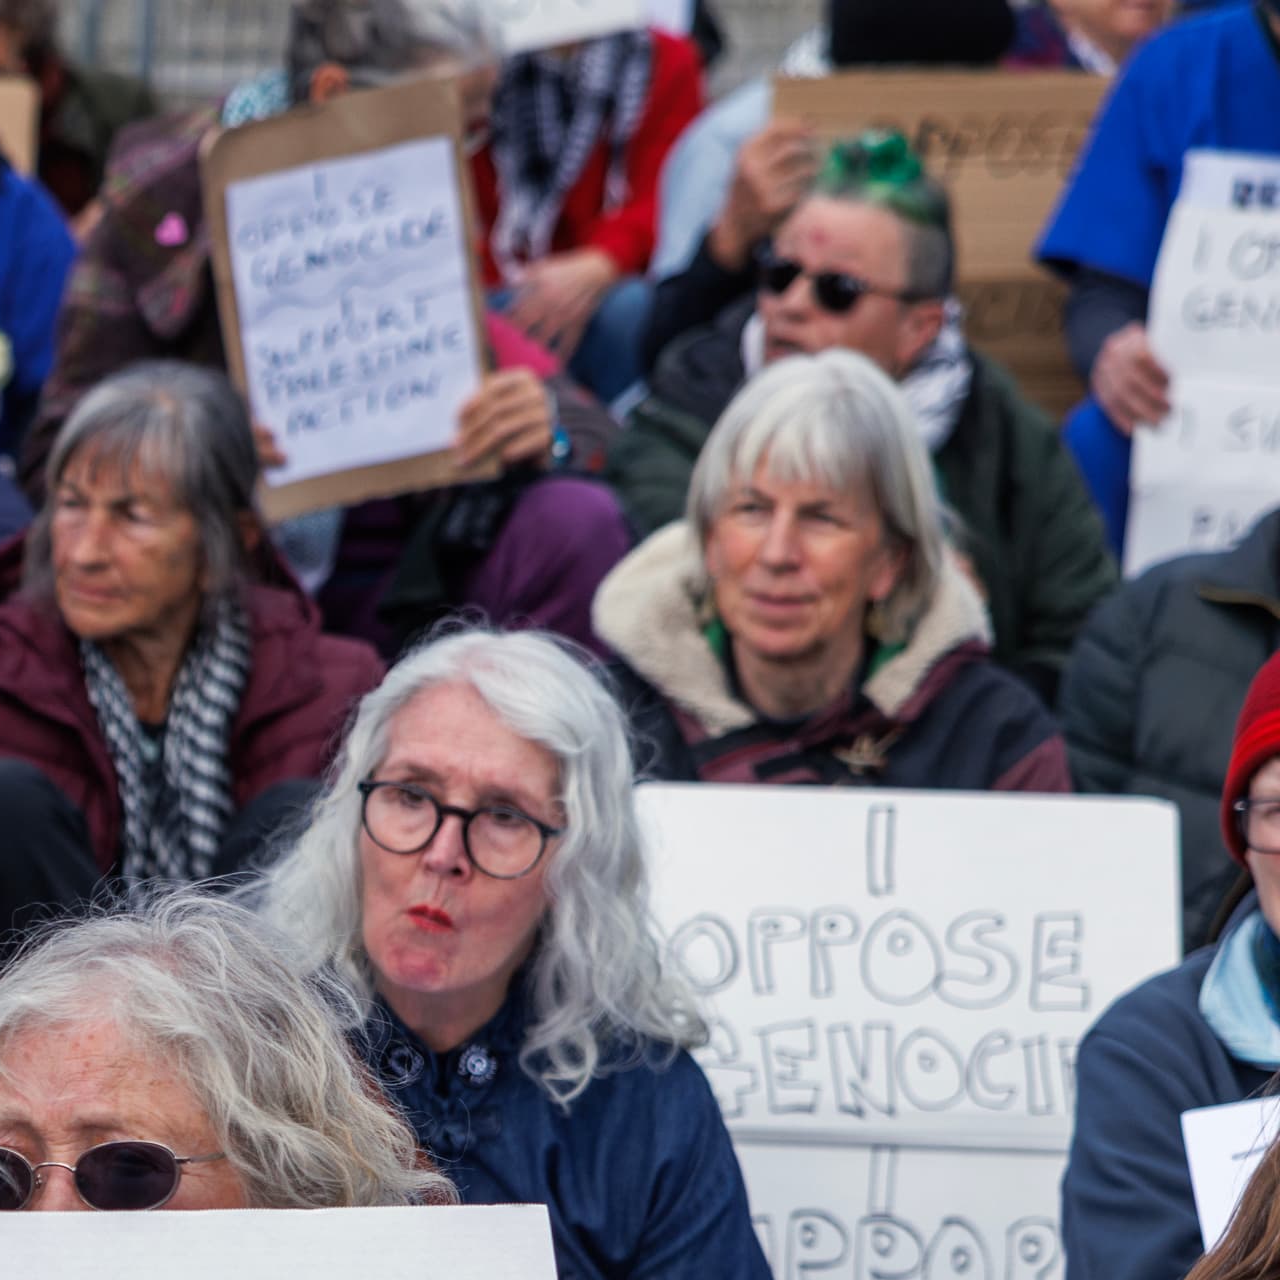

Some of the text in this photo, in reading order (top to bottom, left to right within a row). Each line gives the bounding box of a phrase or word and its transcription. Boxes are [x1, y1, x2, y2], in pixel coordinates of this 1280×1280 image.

[865, 803, 897, 897] I
[672, 907, 1091, 1013] OPPOSE
[704, 1016, 1080, 1120] GENOCI
